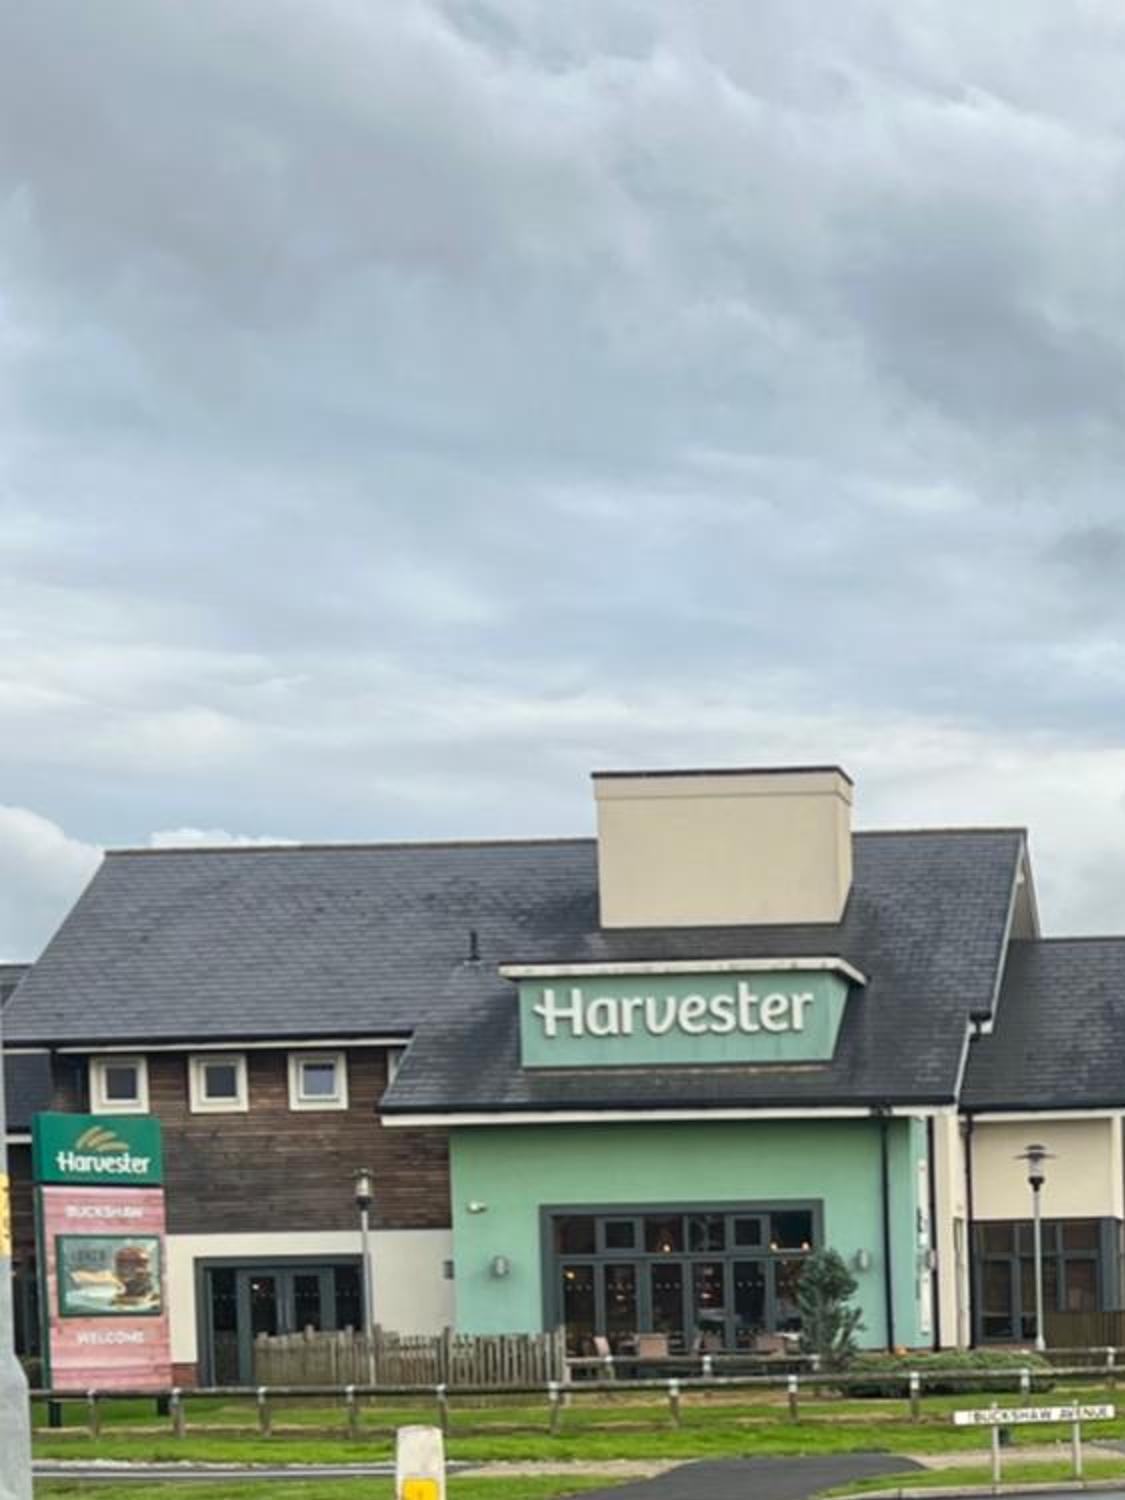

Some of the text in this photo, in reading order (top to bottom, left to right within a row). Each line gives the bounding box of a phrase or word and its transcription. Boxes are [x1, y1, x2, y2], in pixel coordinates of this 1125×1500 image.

[532, 980, 814, 1038] Harvester
[55, 1151, 151, 1174] Harvester
[75, 1330, 145, 1345] WELCOME
[973, 1407, 1107, 1422] BUCKSHAW AVENUE
